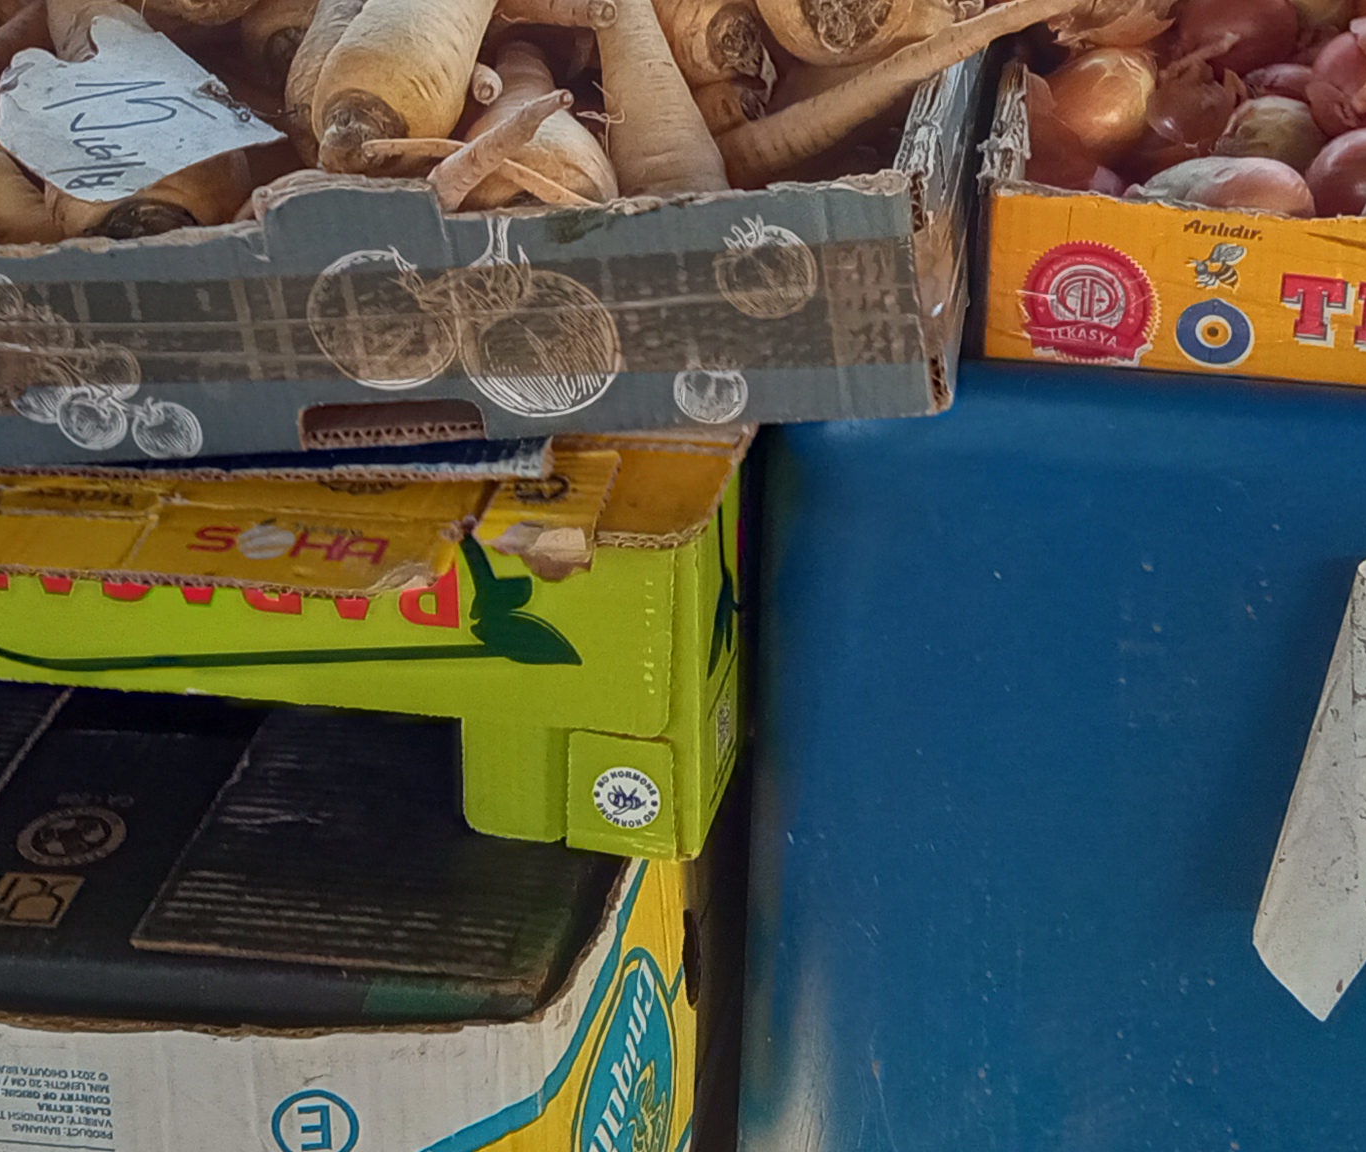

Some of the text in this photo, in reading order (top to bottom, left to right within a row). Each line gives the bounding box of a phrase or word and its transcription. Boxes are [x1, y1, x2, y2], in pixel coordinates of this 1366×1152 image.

[1049, 327, 1118, 347] TEKASYA
[610, 770, 657, 796] HORMONE
[20, 1066, 68, 1079] CHIQUITA
[42, 1092, 57, 1101] OF
[60, 1093, 111, 1105] COUNTRY
[37, 1102, 74, 1114] EXTRA
[8, 1111, 65, 1124] CAVENDISH
[11, 1123, 113, 1140] PRODUCT: BANANAS
[297, 1104, 333, 1150] E
